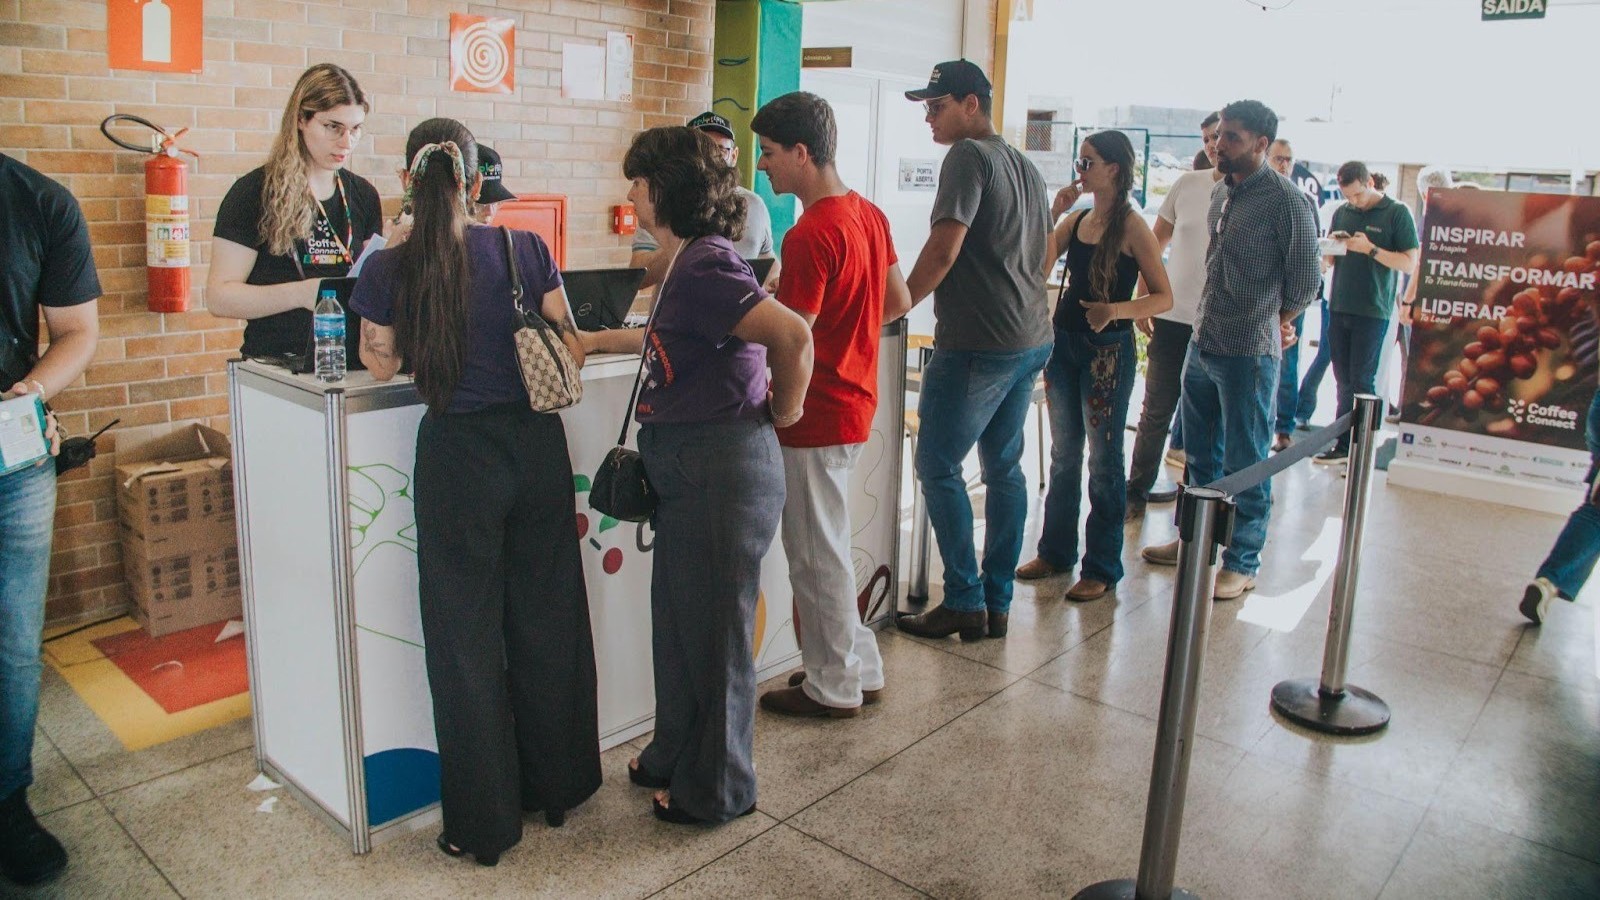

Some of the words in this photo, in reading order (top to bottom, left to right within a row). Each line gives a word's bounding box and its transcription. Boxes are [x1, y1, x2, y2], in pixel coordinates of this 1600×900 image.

[1430, 225, 1525, 248] INSPIRAR
[1429, 242, 1438, 251] To
[1439, 243, 1468, 255] Inspire
[1424, 275, 1434, 284] To
[1436, 276, 1478, 288] Transform
[1427, 259, 1596, 290] TRANSFORMAR
[1421, 298, 1507, 321] LIDERAR
[1420, 312, 1429, 322] To
[1430, 314, 1453, 325] Lead
[1528, 403, 1578, 420] Coffee
[1526, 414, 1576, 430] Connect
